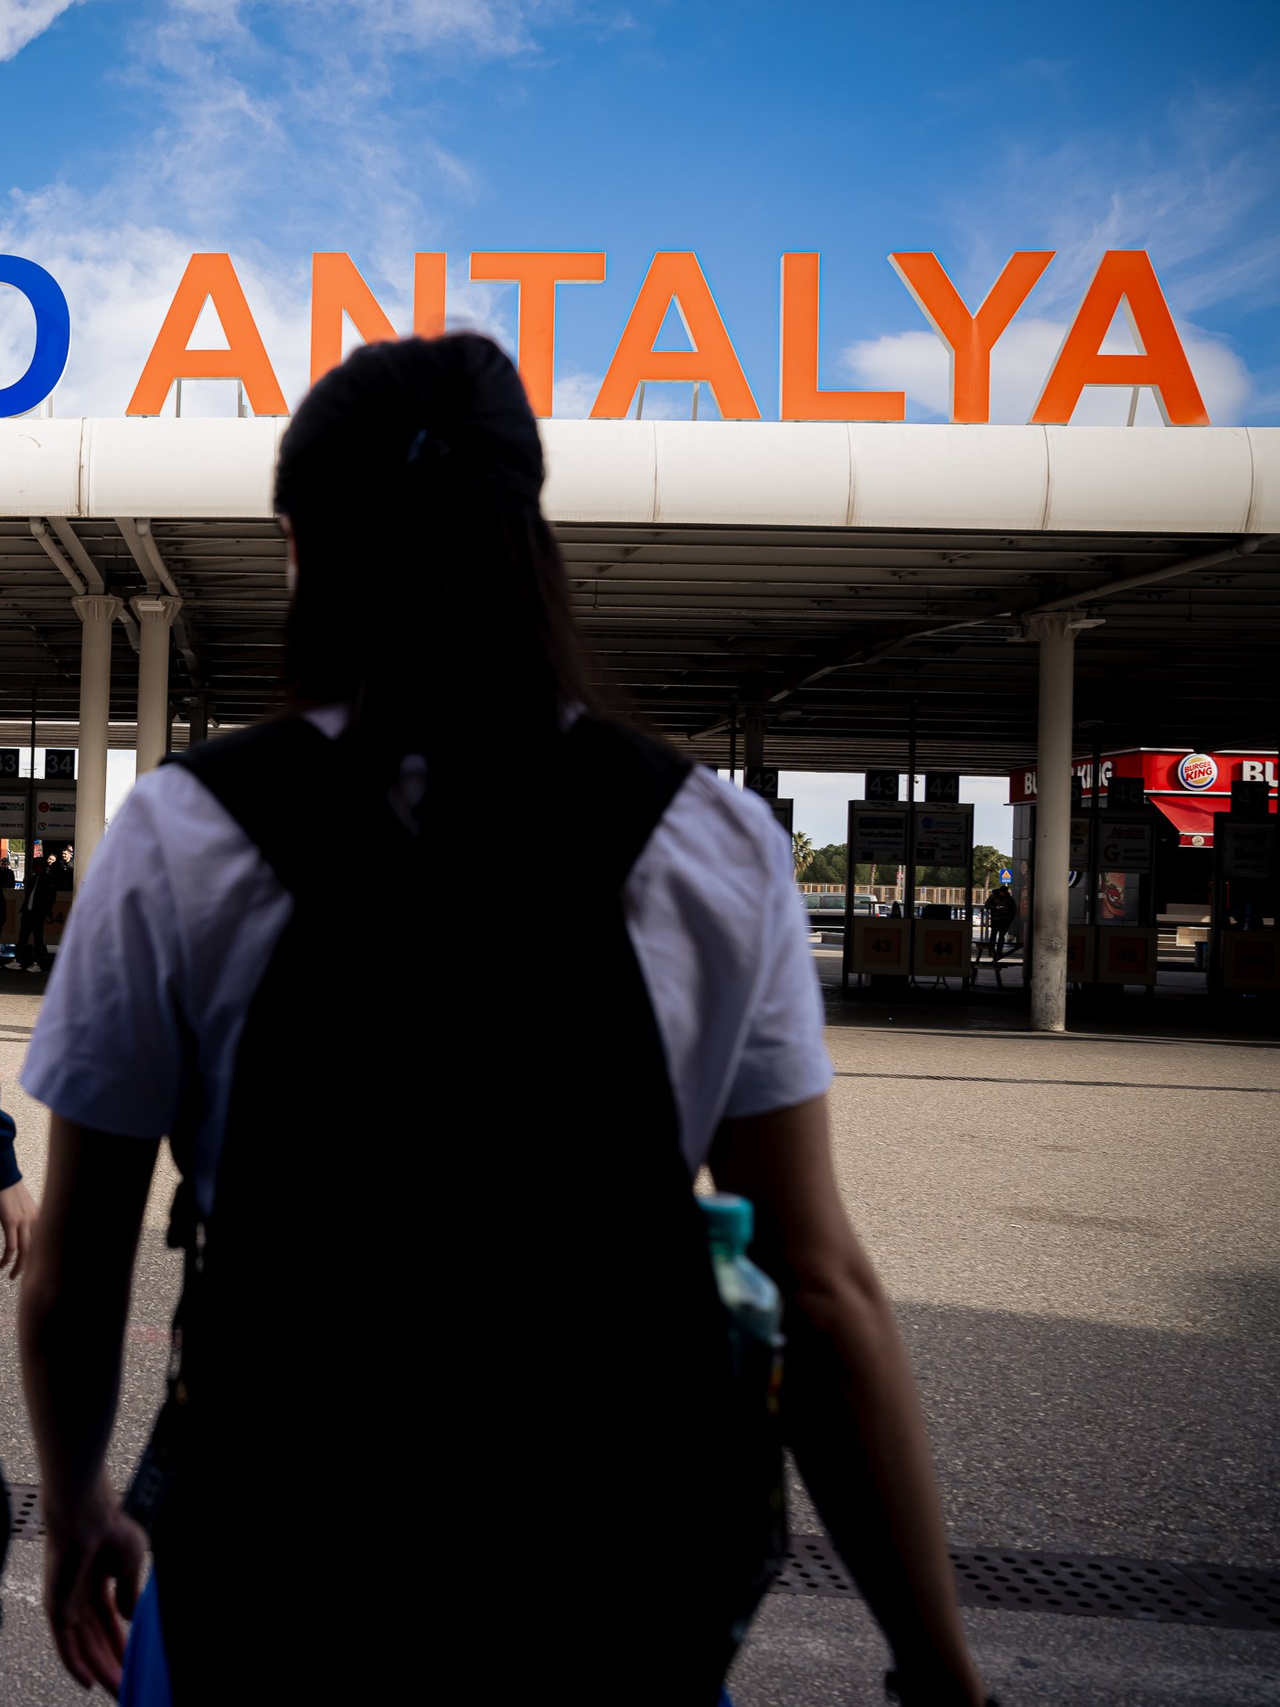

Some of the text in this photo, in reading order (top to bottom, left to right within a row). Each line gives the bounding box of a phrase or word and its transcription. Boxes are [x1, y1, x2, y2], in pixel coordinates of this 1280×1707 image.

[125, 250, 1211, 426] ANTALYA
[47, 754, 73, 774] 34
[1184, 761, 1211, 773] BURGER
[1185, 767, 1212, 781] KING
[748, 772, 777, 792] 42
[869, 775, 897, 795] 43
[930, 777, 958, 797] 44
[1114, 783, 1140, 803] 46
[871, 939, 892, 953] 43
[932, 941, 953, 956] 44
